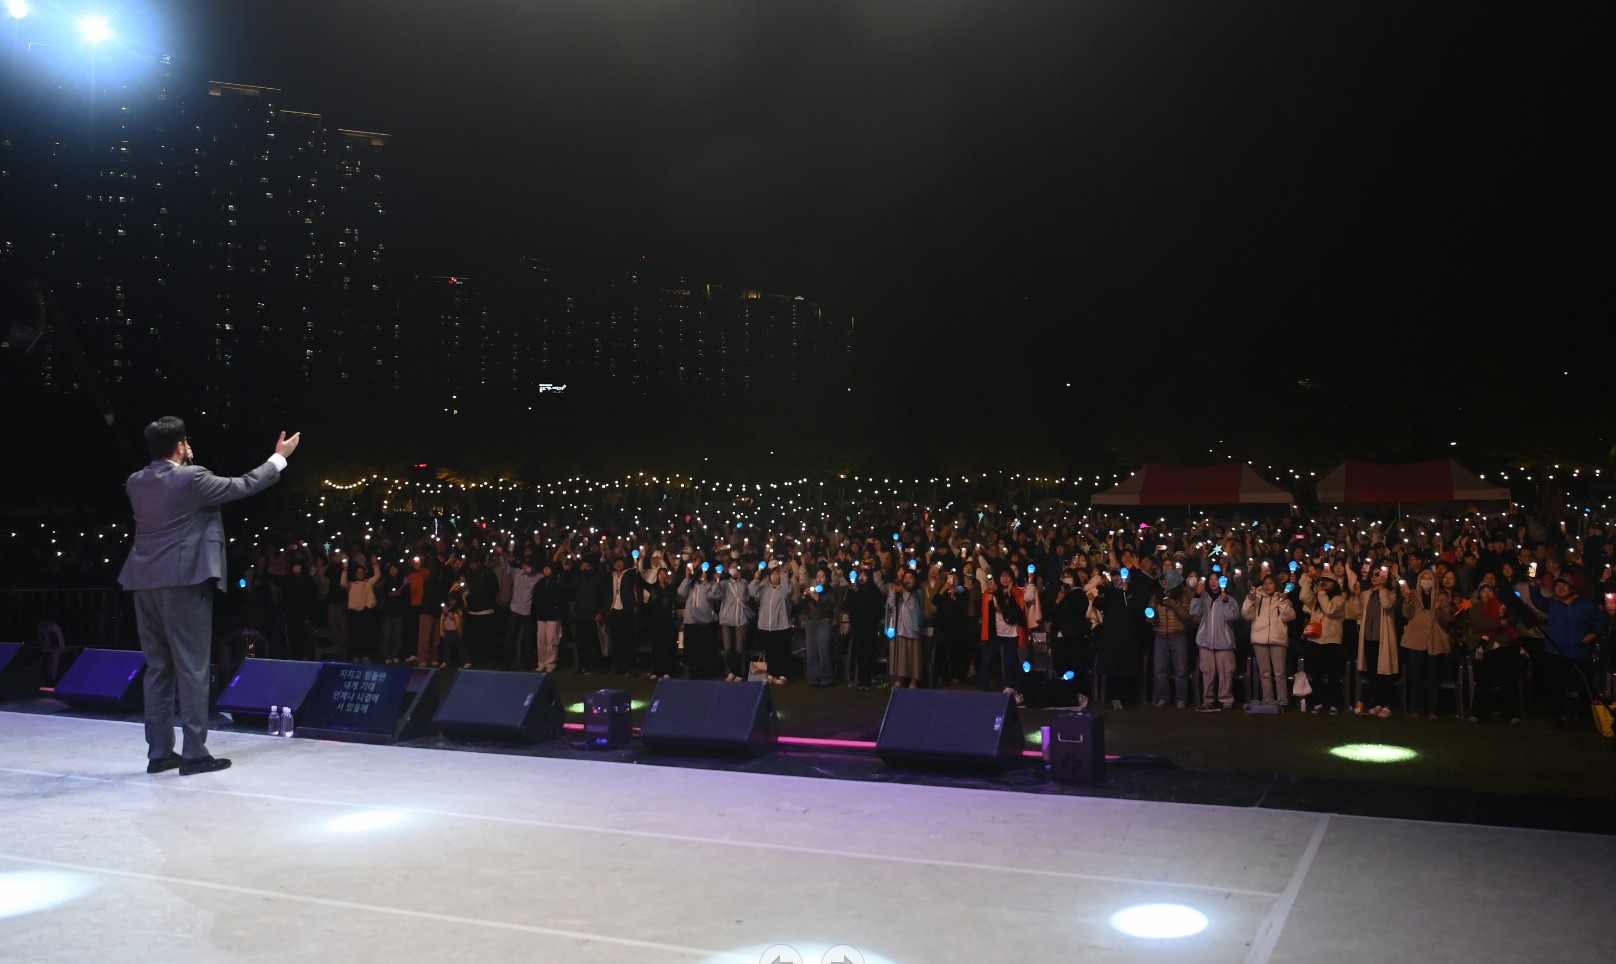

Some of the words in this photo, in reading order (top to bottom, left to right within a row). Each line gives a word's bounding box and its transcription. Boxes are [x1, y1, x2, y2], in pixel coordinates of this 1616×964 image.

[340, 669, 362, 679] 지치고
[344, 681, 359, 690] 내게
[360, 681, 377, 692] 기대
[333, 690, 355, 702] 언제나
[336, 702, 345, 712] 서
